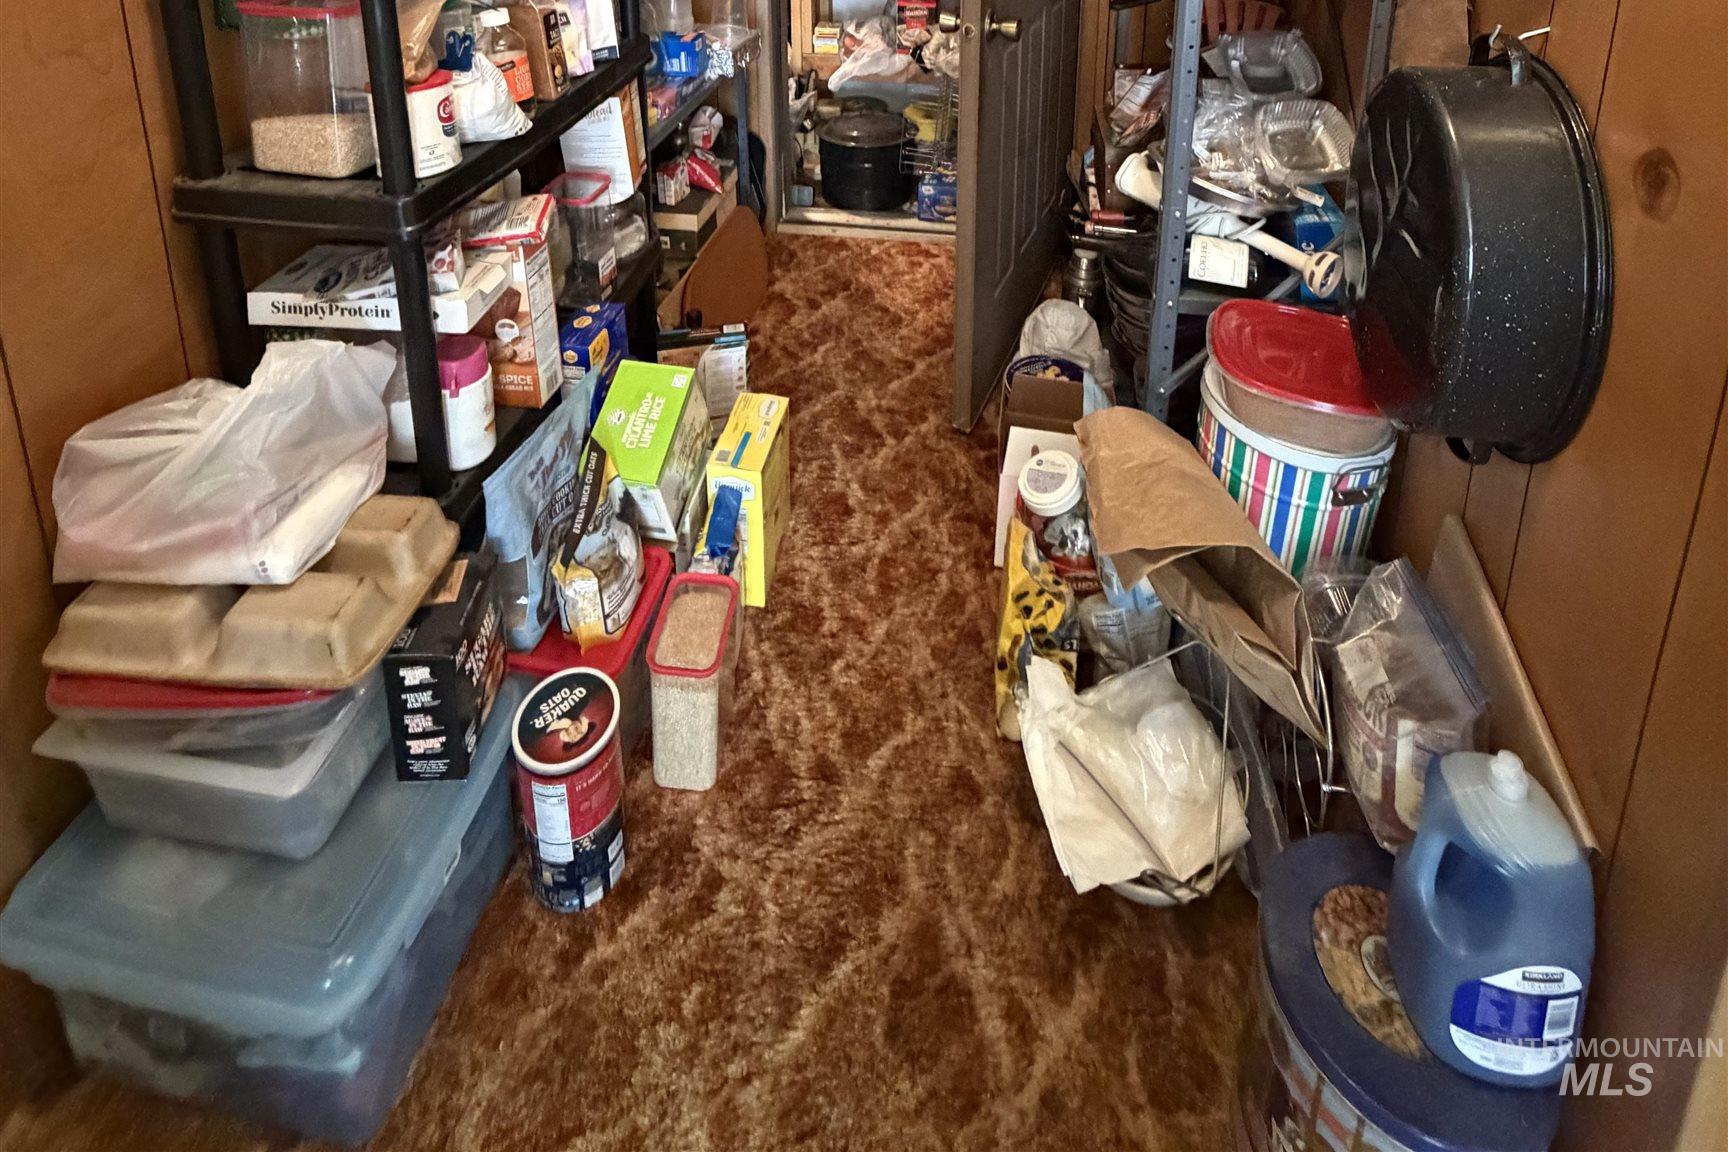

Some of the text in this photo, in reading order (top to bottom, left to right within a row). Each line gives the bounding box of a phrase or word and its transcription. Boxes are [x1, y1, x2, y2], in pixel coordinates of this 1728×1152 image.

[270, 300, 391, 320] SimplyProtein
[499, 374, 533, 385] SPICE
[639, 396, 666, 448] LIME RICE
[572, 451, 598, 535] EXTRA THICK CUT OATS
[534, 687, 587, 729] QUAKER
[539, 687, 571, 714] OATS
